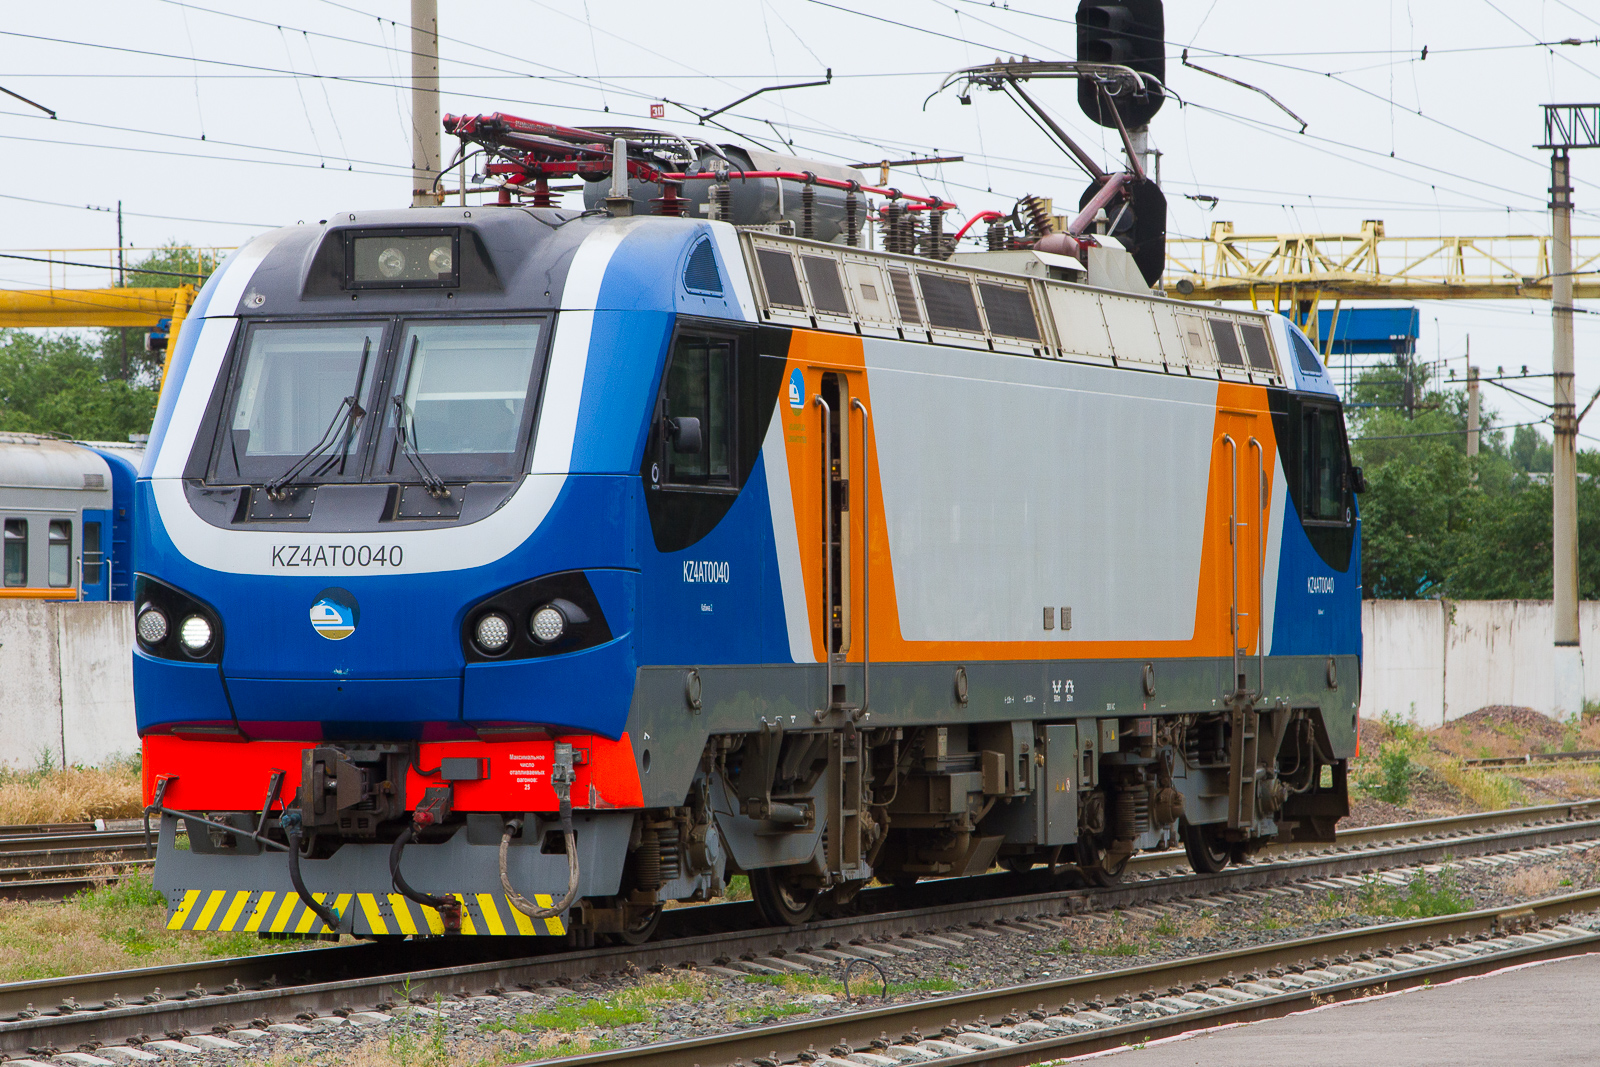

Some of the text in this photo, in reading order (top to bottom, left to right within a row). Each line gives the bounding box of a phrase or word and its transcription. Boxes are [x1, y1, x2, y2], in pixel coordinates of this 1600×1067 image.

[272, 545, 403, 567] KZ4AT0040
[684, 561, 729, 583] KZ4AT0040
[1308, 577, 1334, 593] KZ4AT0040
